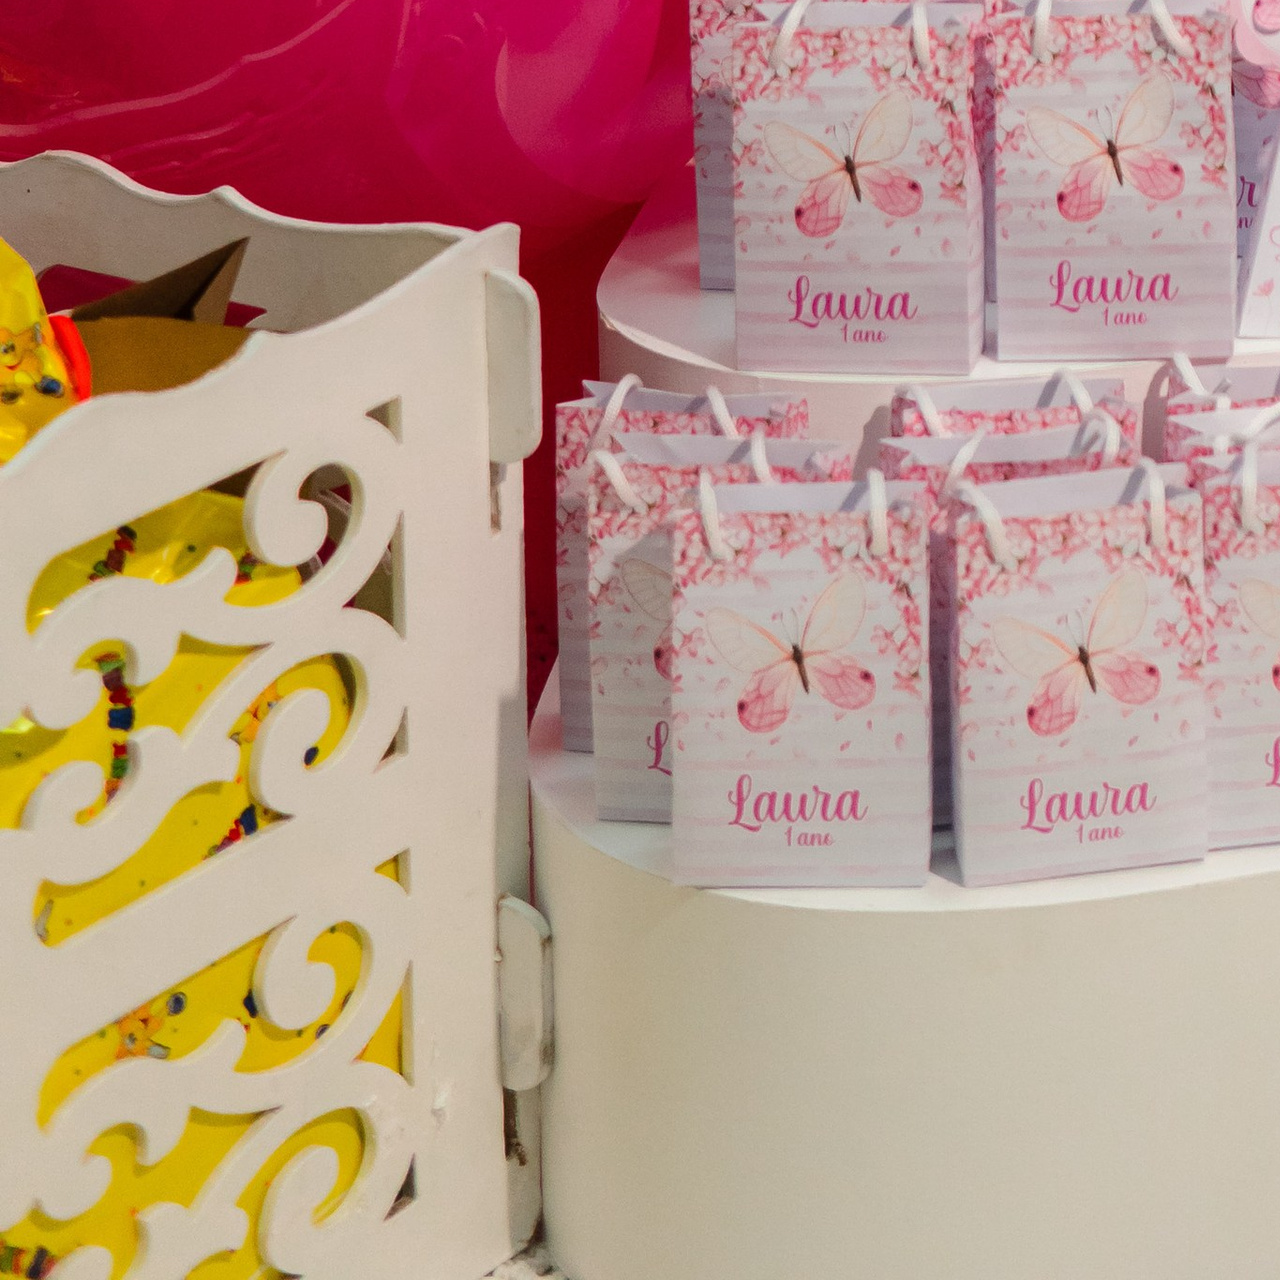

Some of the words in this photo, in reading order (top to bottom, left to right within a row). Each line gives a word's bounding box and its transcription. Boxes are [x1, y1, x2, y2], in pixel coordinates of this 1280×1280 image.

[787, 274, 918, 329] Laura
[1048, 259, 1179, 313] Laura
[841, 323, 848, 343] 1
[852, 329, 887, 343] ano
[1102, 306, 1109, 326] 1
[1113, 311, 1147, 326] ano
[727, 773, 869, 832] Laura
[1019, 777, 1157, 834] Laura
[784, 826, 793, 846] 1
[797, 832, 834, 846] ano
[1076, 823, 1083, 844] 1
[1088, 826, 1124, 841] ano
